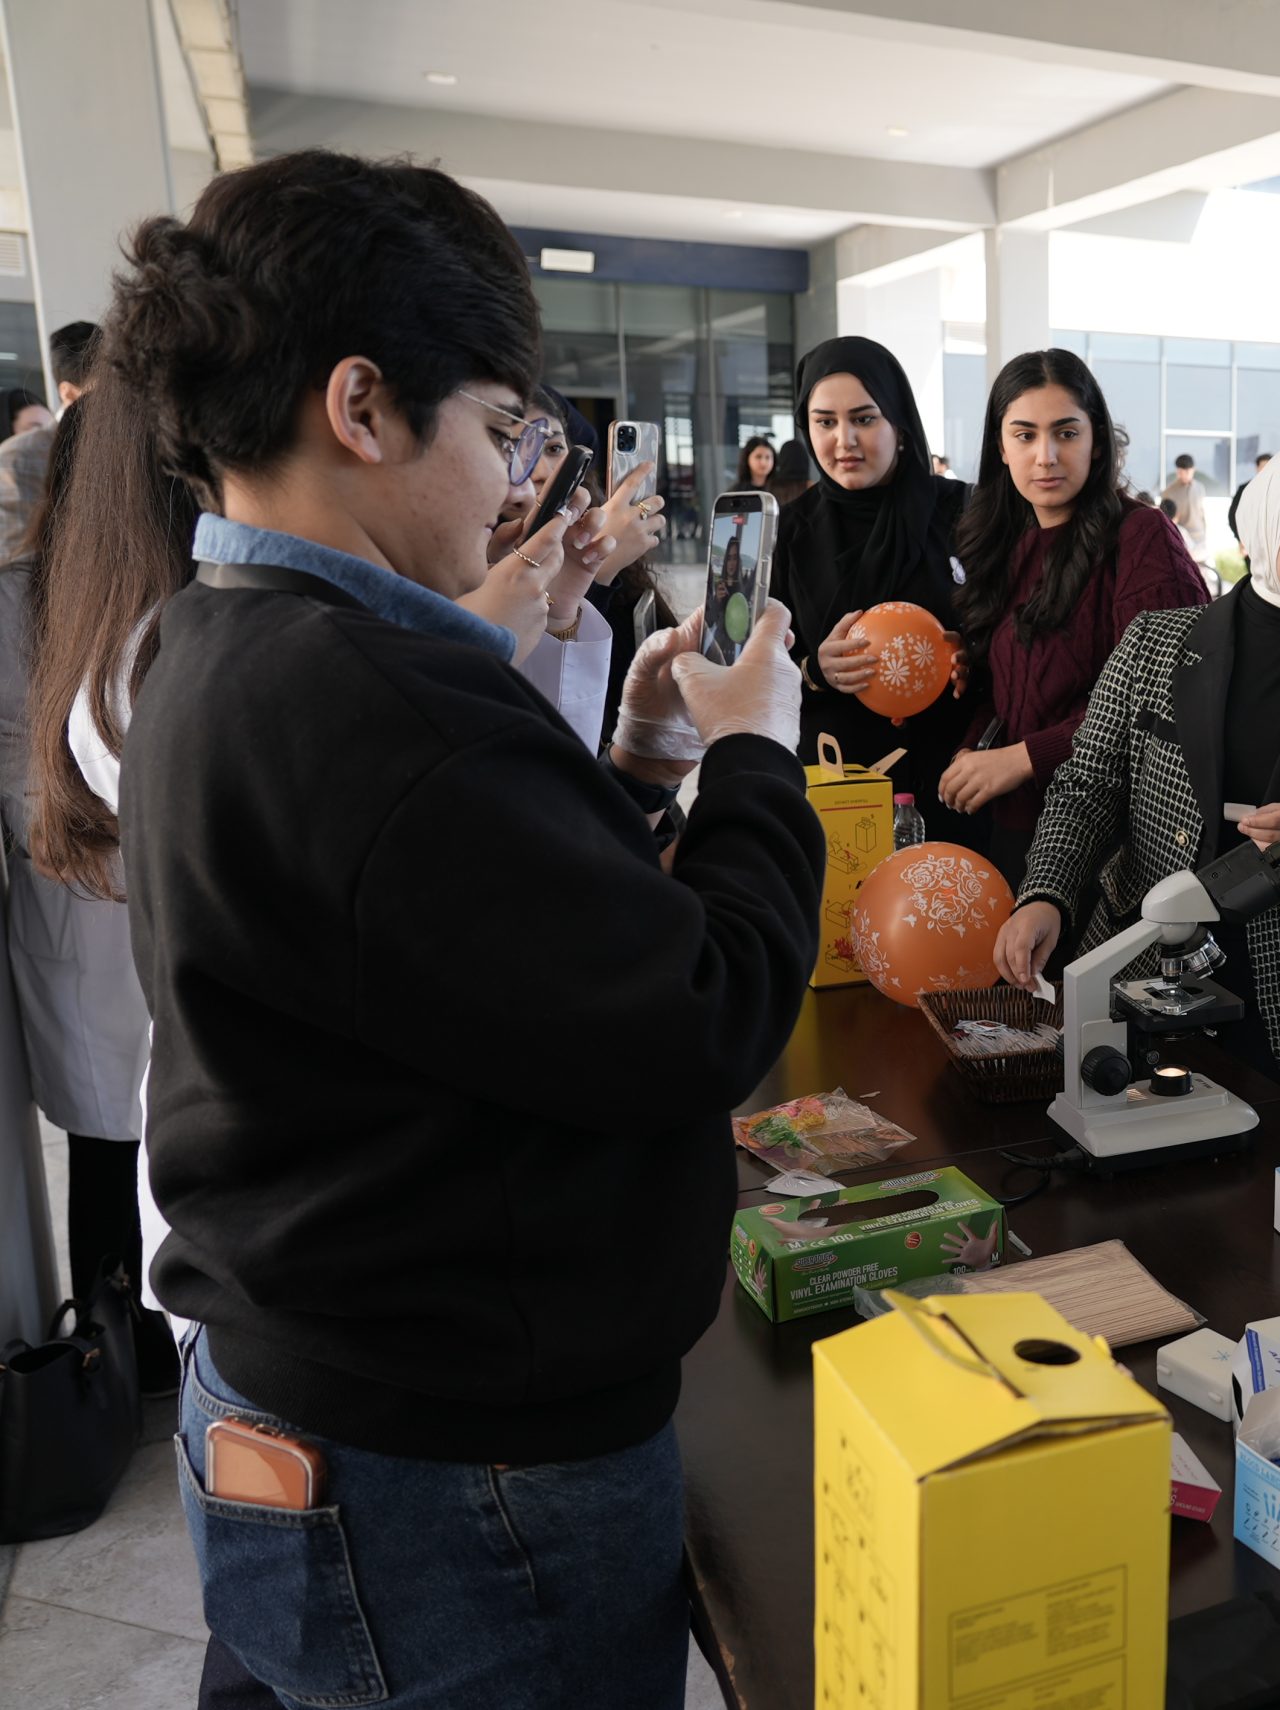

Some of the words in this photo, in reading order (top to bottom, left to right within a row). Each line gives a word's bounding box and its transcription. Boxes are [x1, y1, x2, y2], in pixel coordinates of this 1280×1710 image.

[859, 1221, 883, 1231] VINYL
[883, 1207, 944, 1226] EXAMINATION
[945, 1198, 979, 1211] GLOVES
[830, 1233, 853, 1244] 100
[787, 1241, 802, 1250] M
[991, 1252, 999, 1262] M
[809, 1274, 831, 1286] CLEAR
[832, 1266, 862, 1281] POWDER
[862, 1262, 879, 1272] FREE
[953, 1265, 966, 1277] 100
[790, 1287, 813, 1300] VINYL
[815, 1274, 867, 1295] EXAMINATION
[868, 1266, 898, 1281] GLOVES
